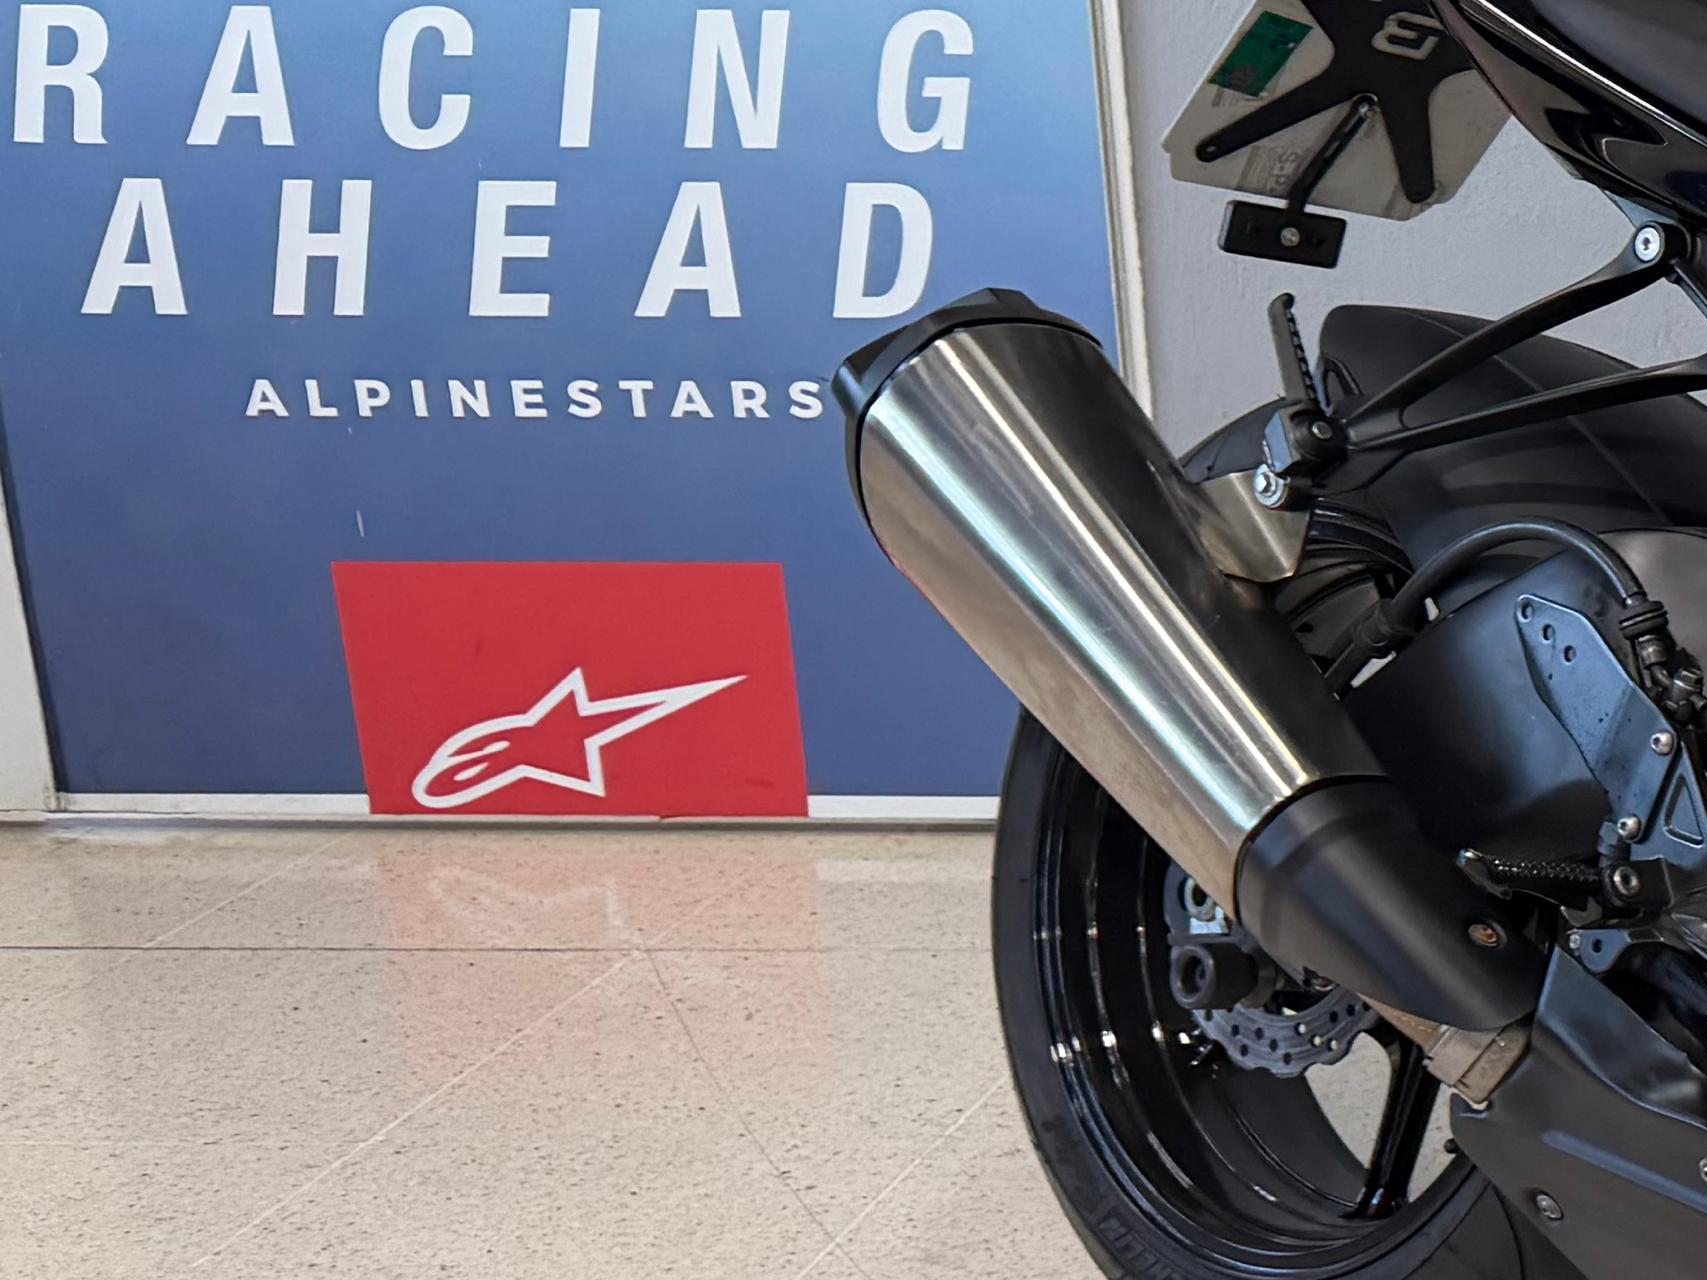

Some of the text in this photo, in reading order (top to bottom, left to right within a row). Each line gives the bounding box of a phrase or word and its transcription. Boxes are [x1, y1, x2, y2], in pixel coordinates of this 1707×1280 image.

[13, 4, 975, 152] RACING
[81, 177, 936, 319] AHEAD
[246, 377, 824, 420] ALPINESTARS
